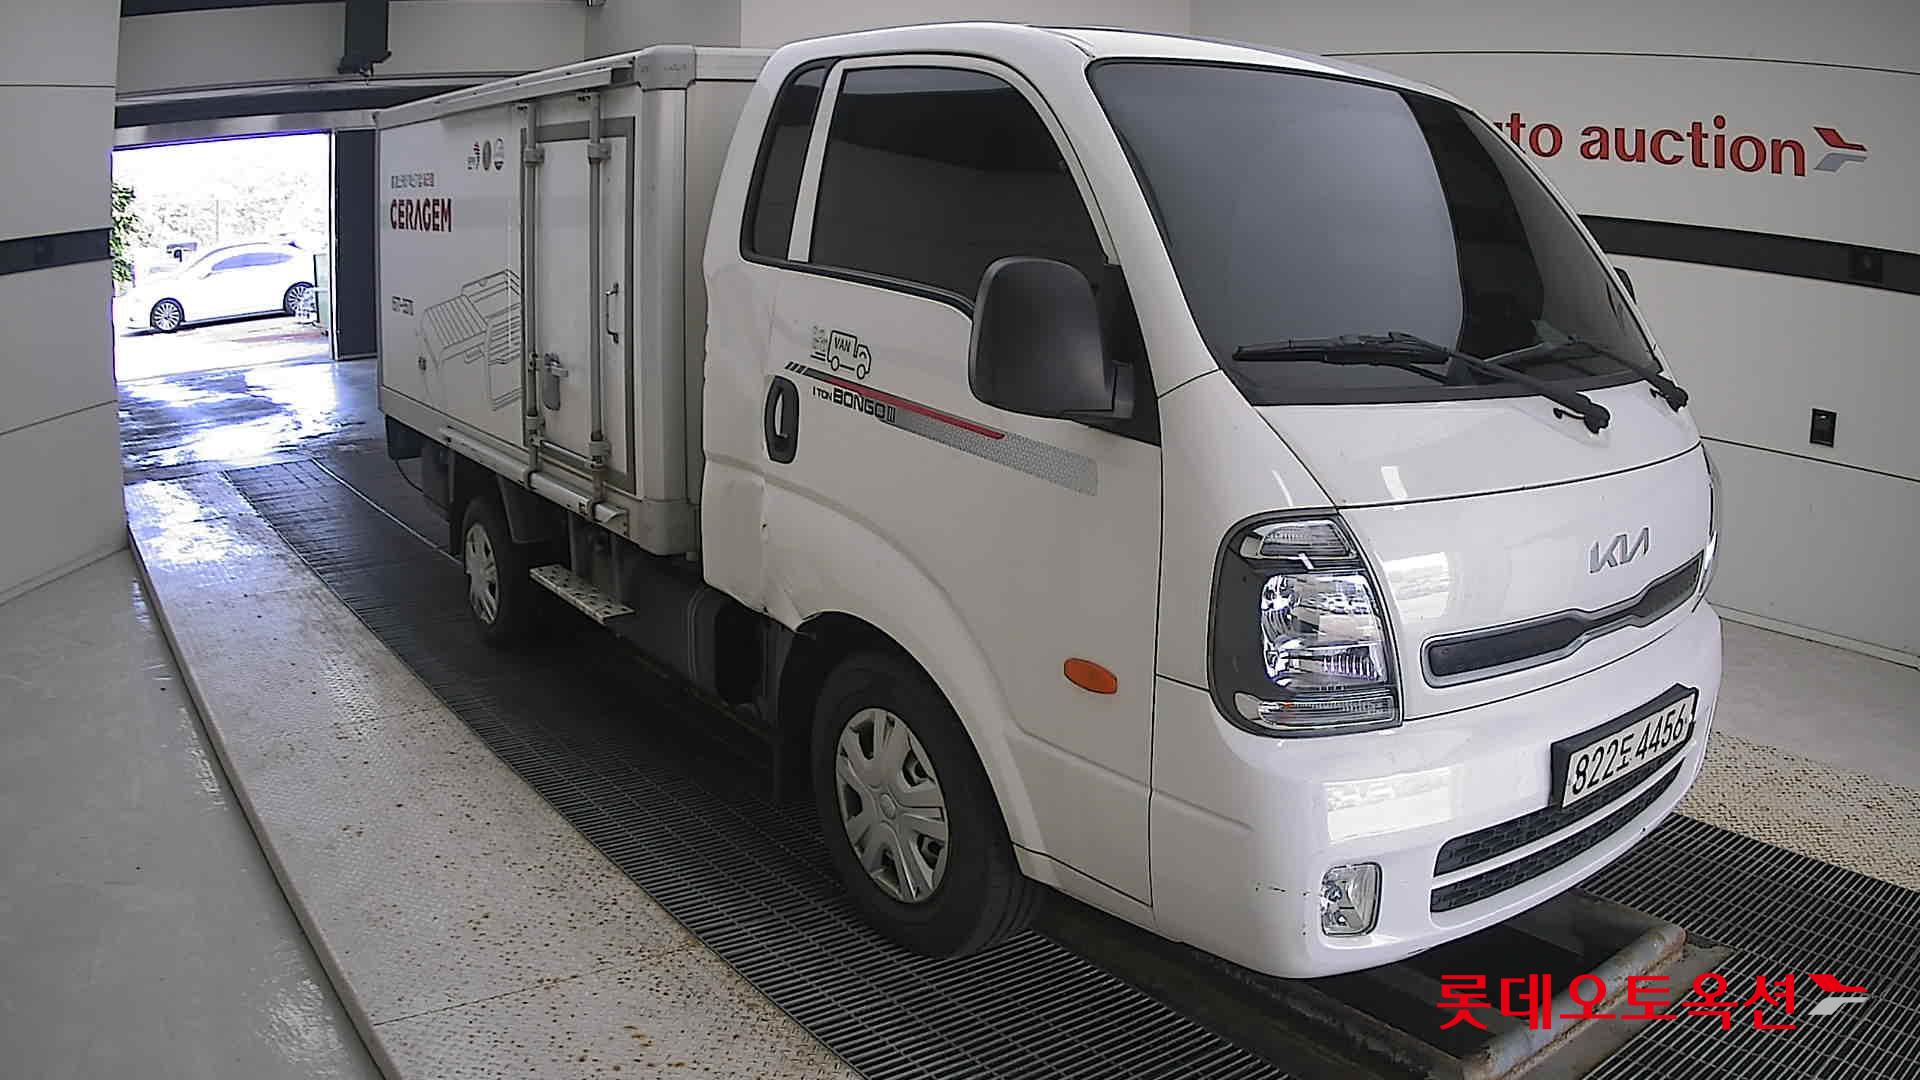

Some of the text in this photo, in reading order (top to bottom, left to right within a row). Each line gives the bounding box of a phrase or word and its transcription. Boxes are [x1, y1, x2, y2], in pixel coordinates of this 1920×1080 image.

[1493, 113, 1806, 176] to auction
[390, 198, 452, 232] CERAGEM
[834, 336, 851, 353] VAN
[1589, 527, 1650, 574] KIA
